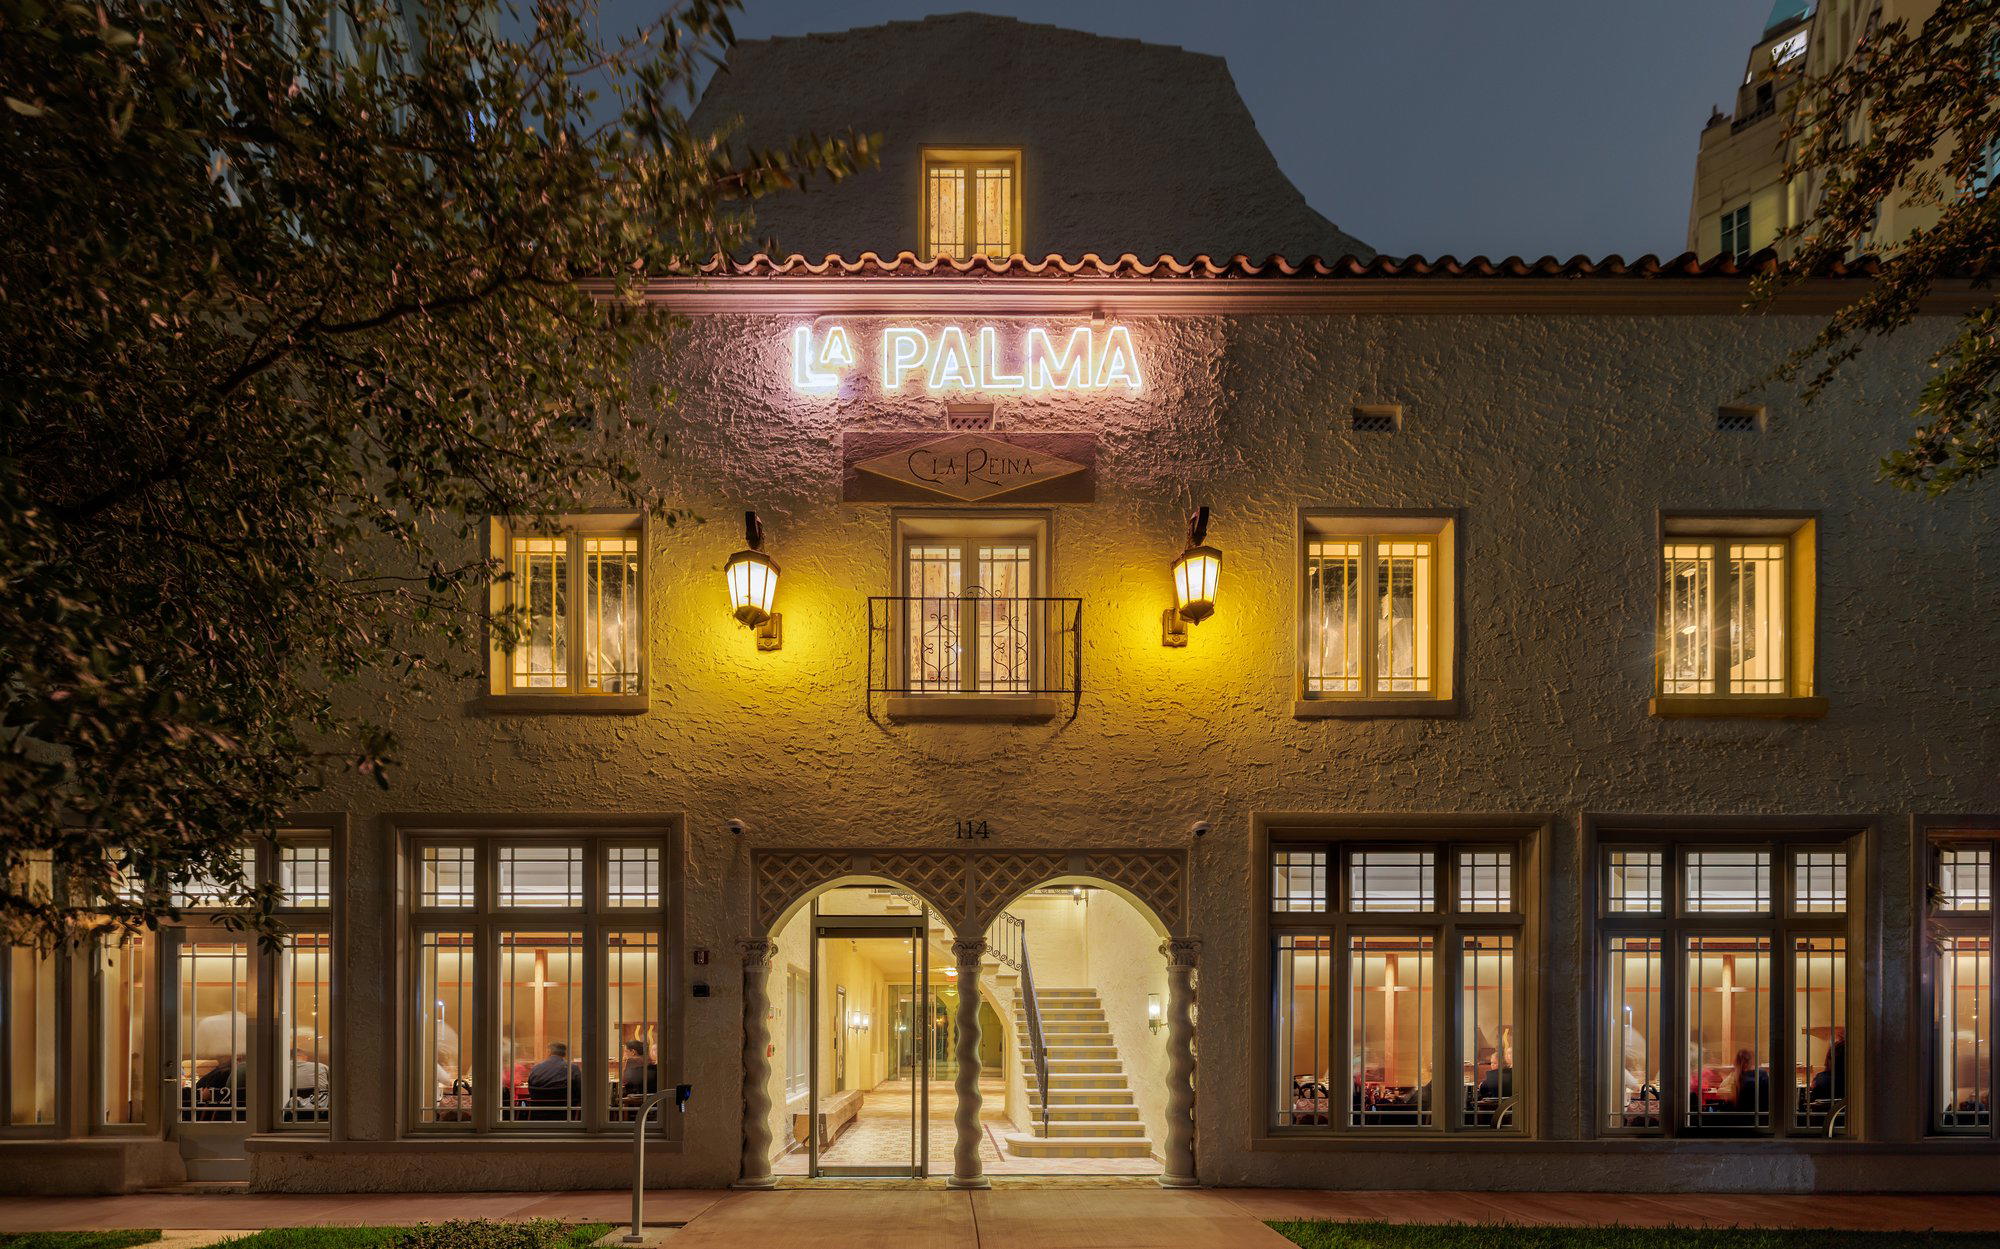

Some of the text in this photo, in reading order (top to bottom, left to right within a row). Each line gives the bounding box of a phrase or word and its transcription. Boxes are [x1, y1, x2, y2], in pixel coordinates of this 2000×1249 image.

[795, 326, 1142, 390] LA PALMA
[955, 820, 990, 839] 114
[196, 1086, 231, 1105] 112
